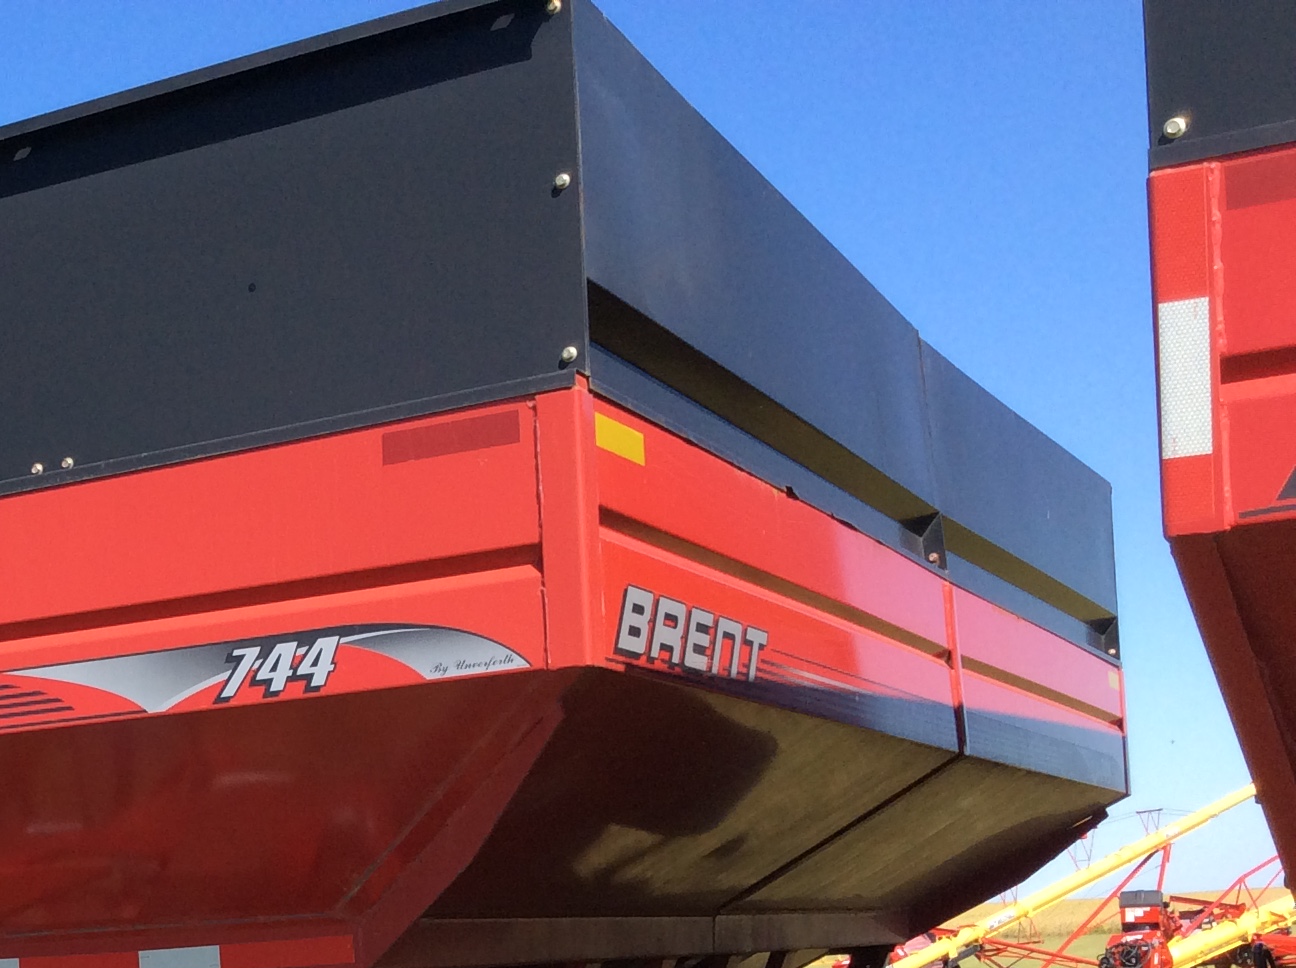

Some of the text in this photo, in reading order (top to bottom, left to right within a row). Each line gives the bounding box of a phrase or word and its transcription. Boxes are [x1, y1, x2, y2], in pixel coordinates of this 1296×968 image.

[613, 583, 769, 683] BRENT
[214, 635, 341, 704] 744
[430, 662, 449, 676] By
